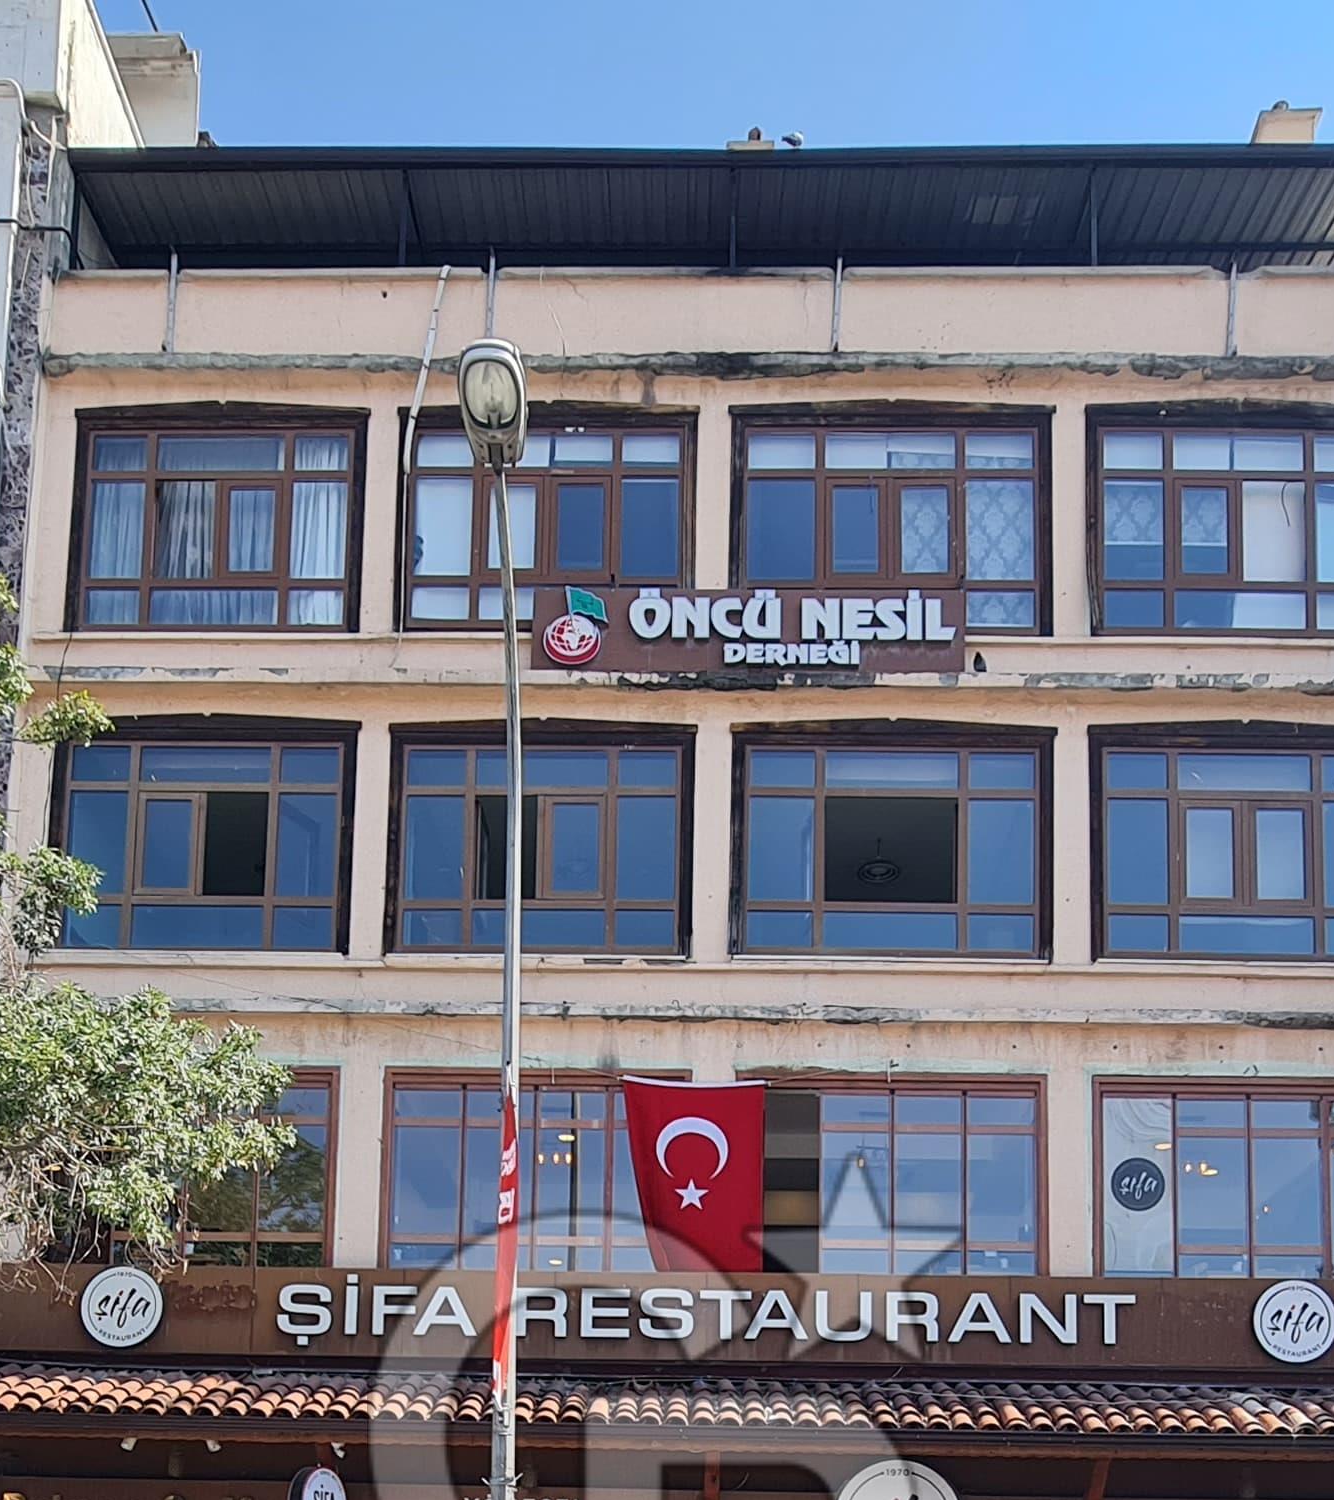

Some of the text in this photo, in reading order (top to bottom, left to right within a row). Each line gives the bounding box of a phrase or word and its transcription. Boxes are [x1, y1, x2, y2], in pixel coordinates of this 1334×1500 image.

[629, 587, 957, 641] ÖNCÜ NESİL
[723, 640, 861, 666] DERNEĞİ
[95, 1287, 151, 1329] şifa
[276, 1273, 1137, 1346] ŞİFA RESTAURANT
[1267, 1302, 1325, 1344] şifa
[98, 1328, 147, 1342] RESTAURANT
[1273, 1342, 1323, 1358] RESTAURANT
[885, 1468, 911, 1477] 1970
